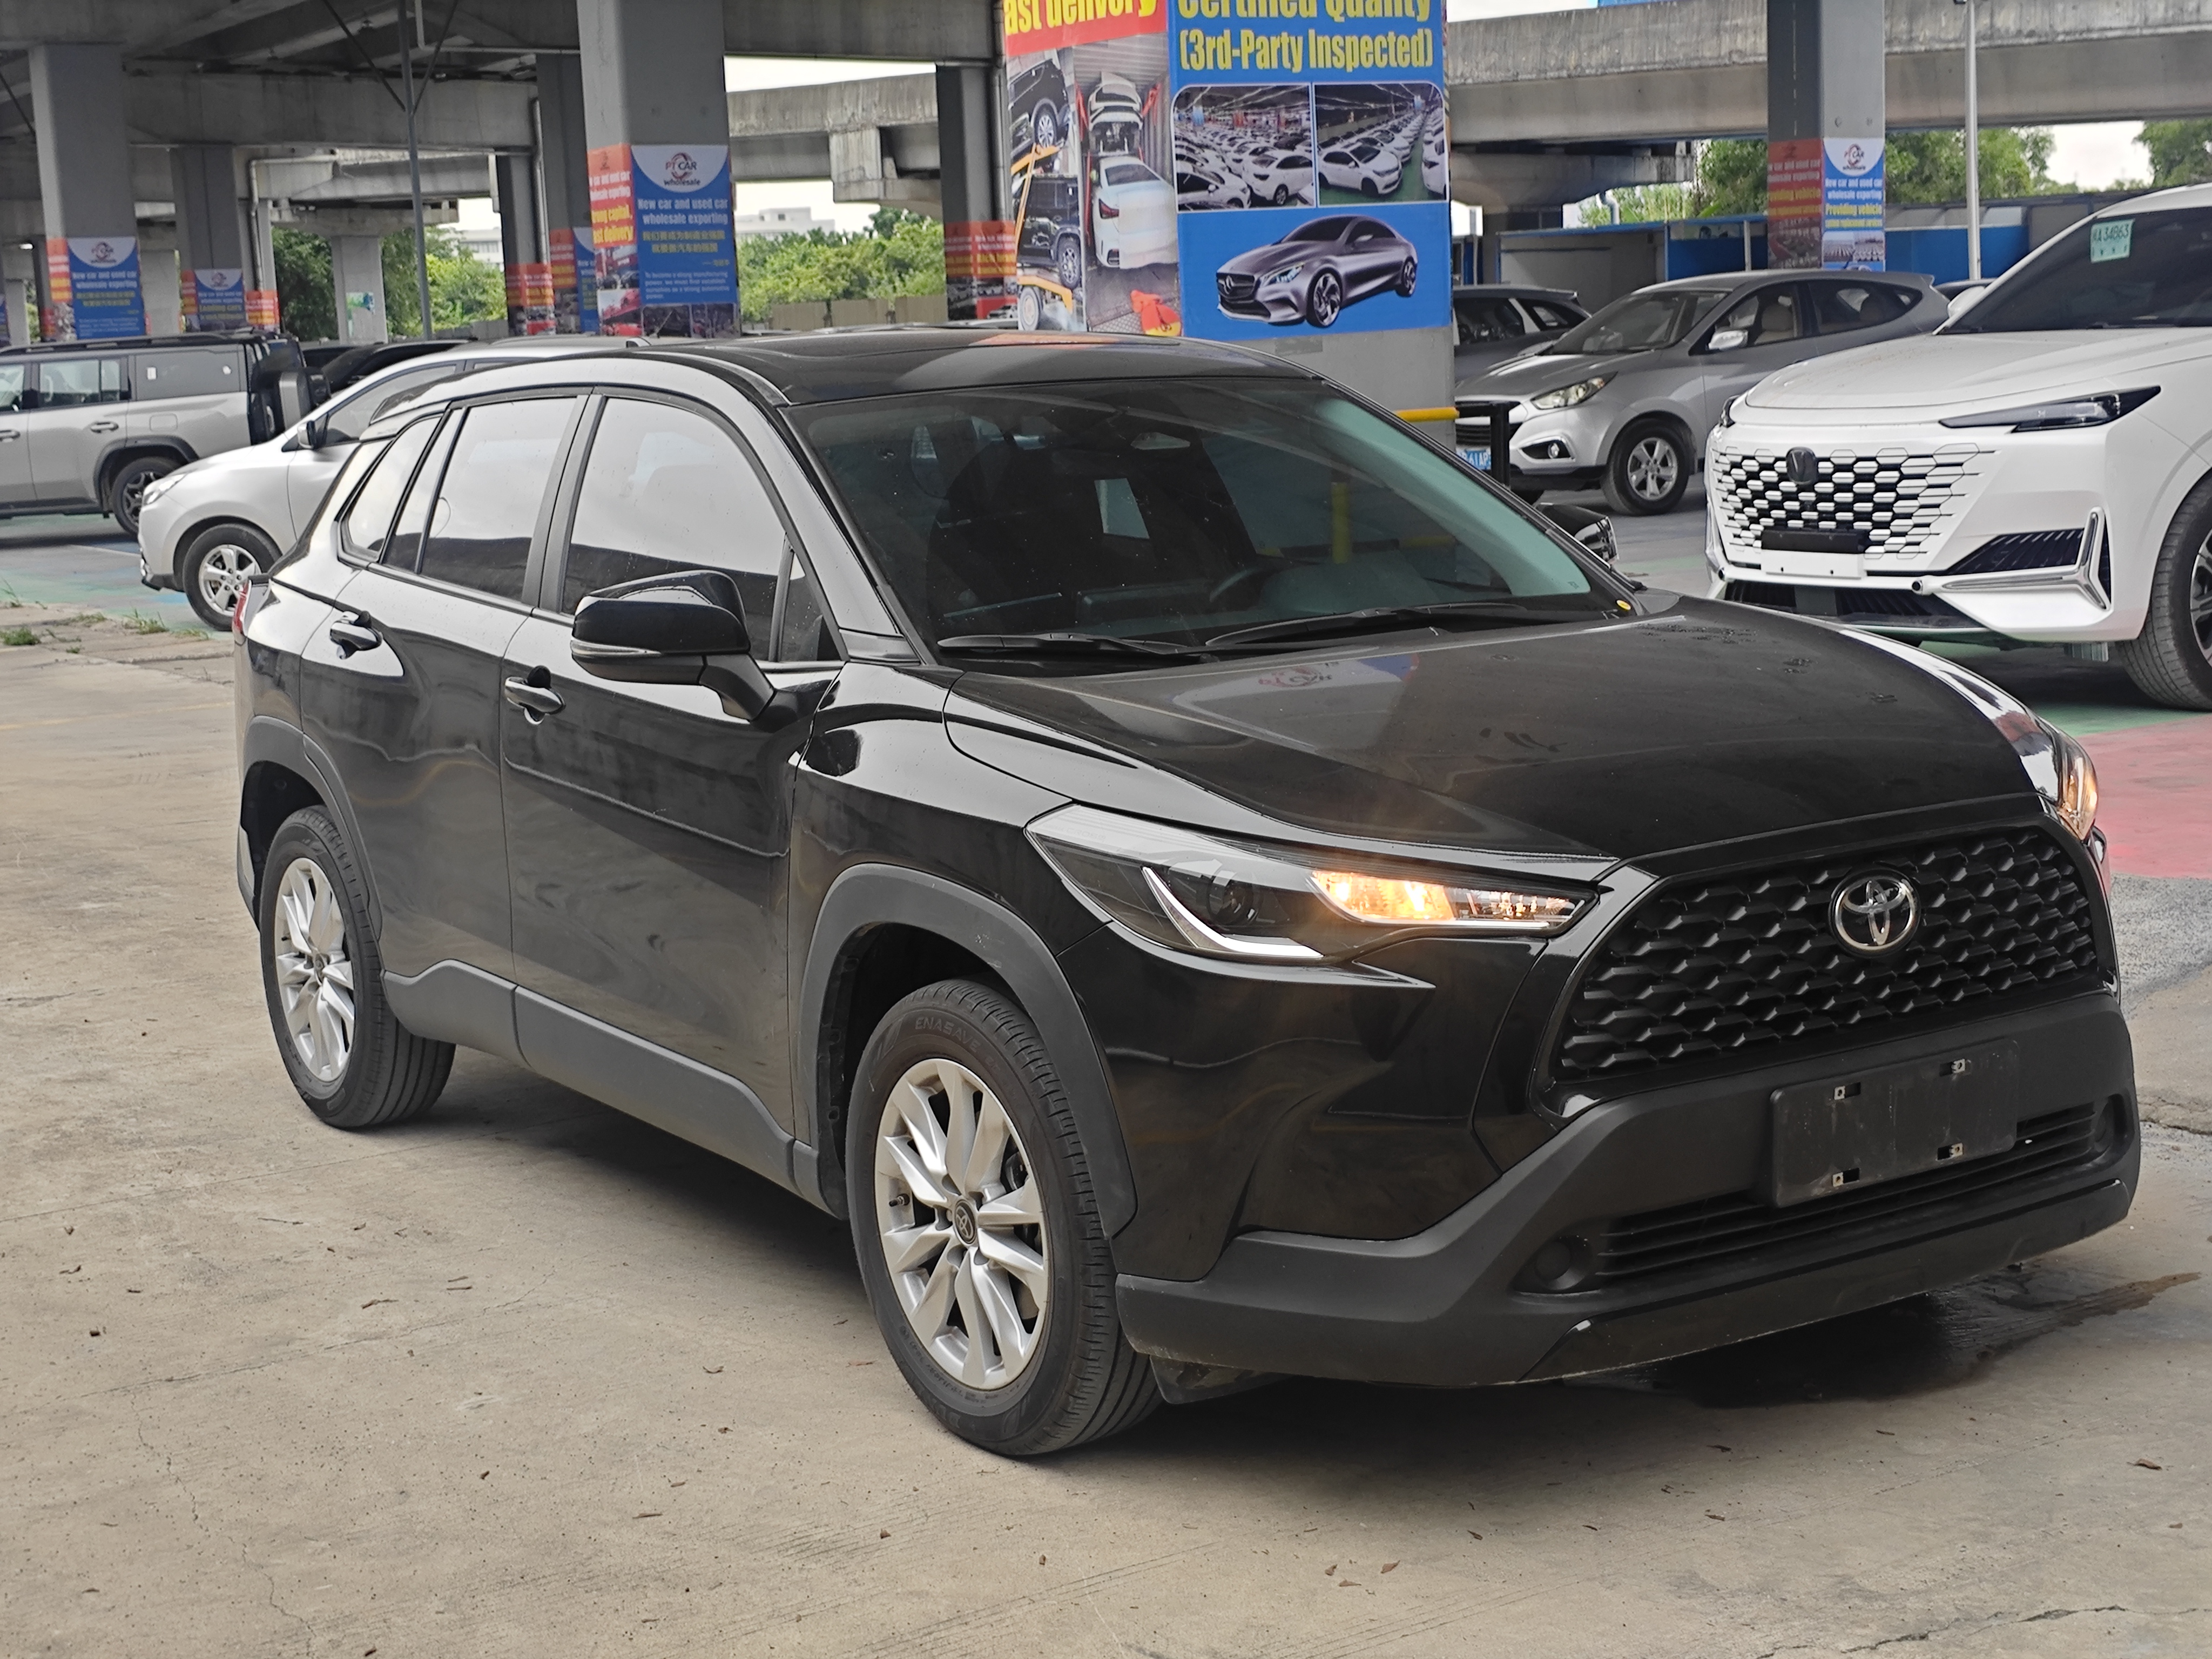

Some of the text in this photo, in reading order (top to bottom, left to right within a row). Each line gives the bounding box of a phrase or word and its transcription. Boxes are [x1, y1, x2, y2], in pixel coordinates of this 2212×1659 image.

[1179, 28, 1434, 73] (3rd-Party Inspected)
[1847, 177, 1859, 187] and
[1859, 177, 1873, 187] used
[637, 198, 728, 210] New car and used car
[642, 212, 728, 225] wholesale exporting
[915, 1017, 981, 1053] ENASAVE
